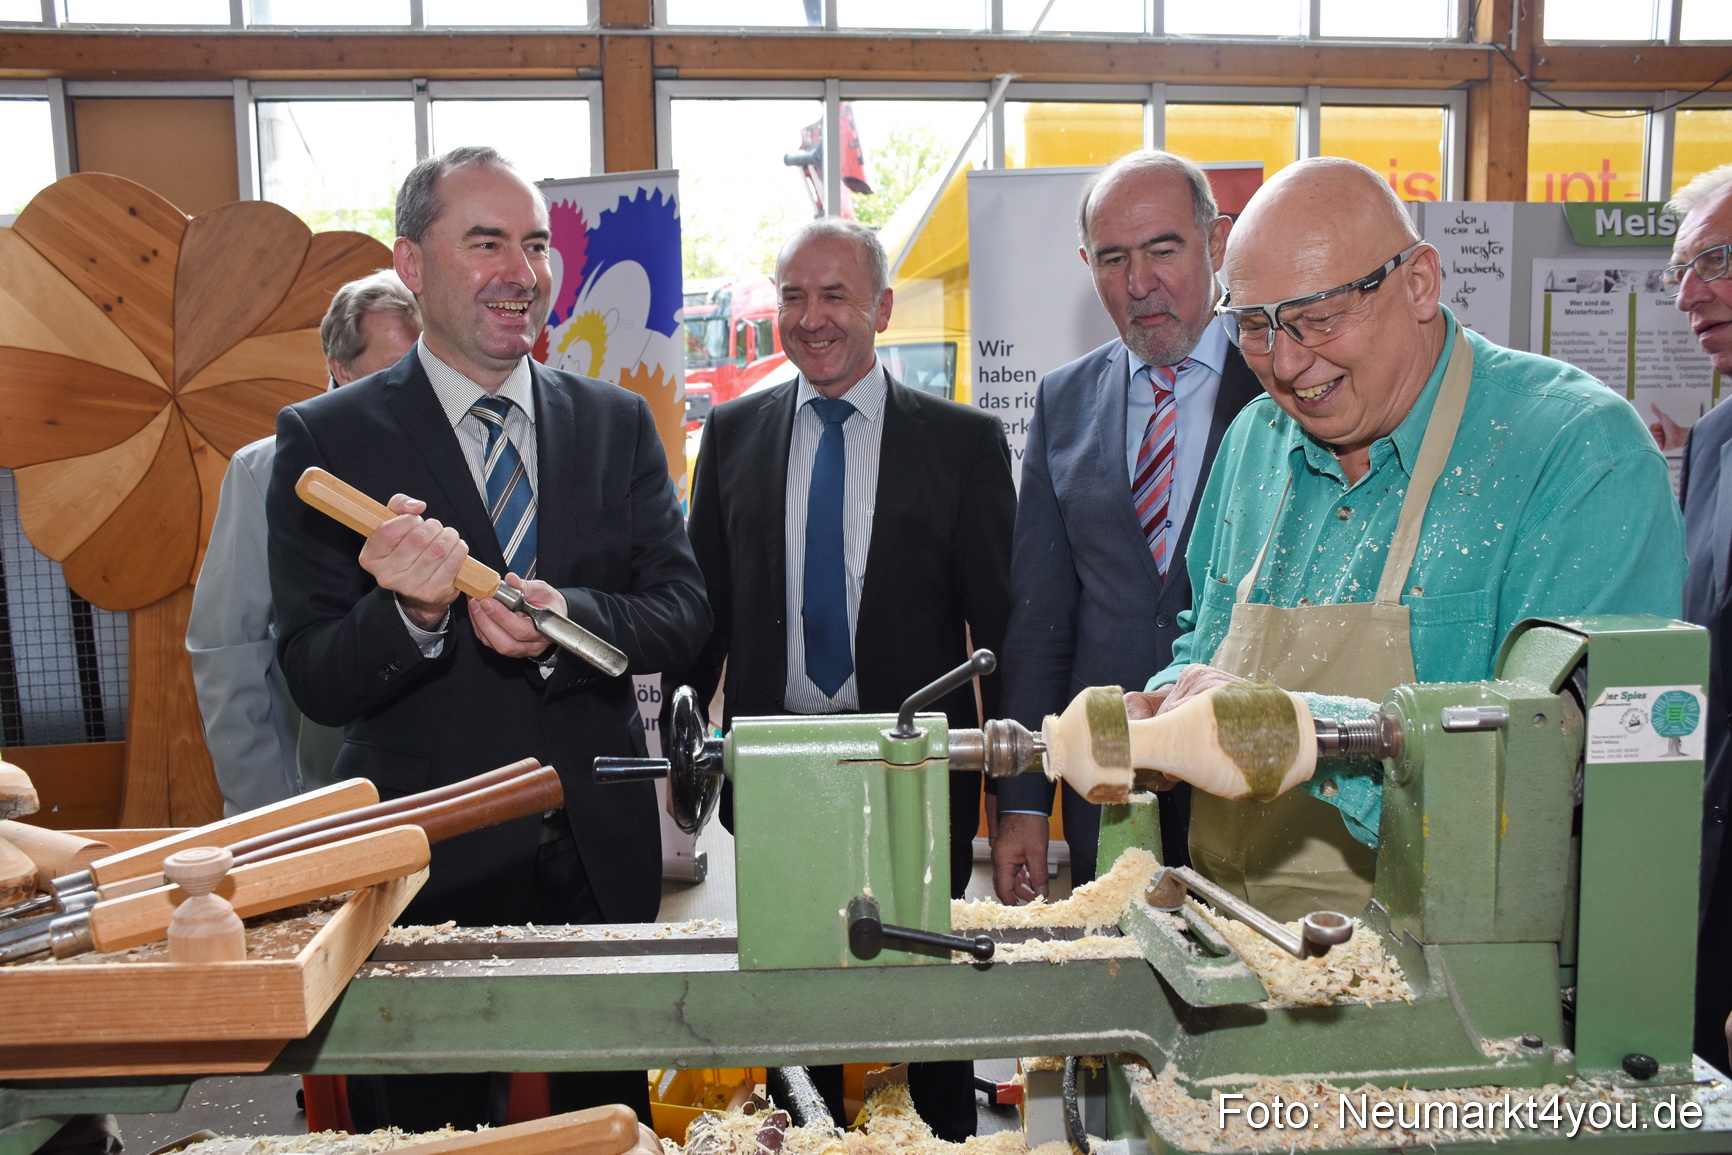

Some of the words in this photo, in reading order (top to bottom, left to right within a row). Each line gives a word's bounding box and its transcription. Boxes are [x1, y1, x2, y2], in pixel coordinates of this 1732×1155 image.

[1595, 208, 1682, 237] Meis
[978, 340, 1014, 357] Wir
[979, 365, 1036, 383] haben
[979, 392, 1010, 409] das
[1620, 691, 1647, 702] Spies
